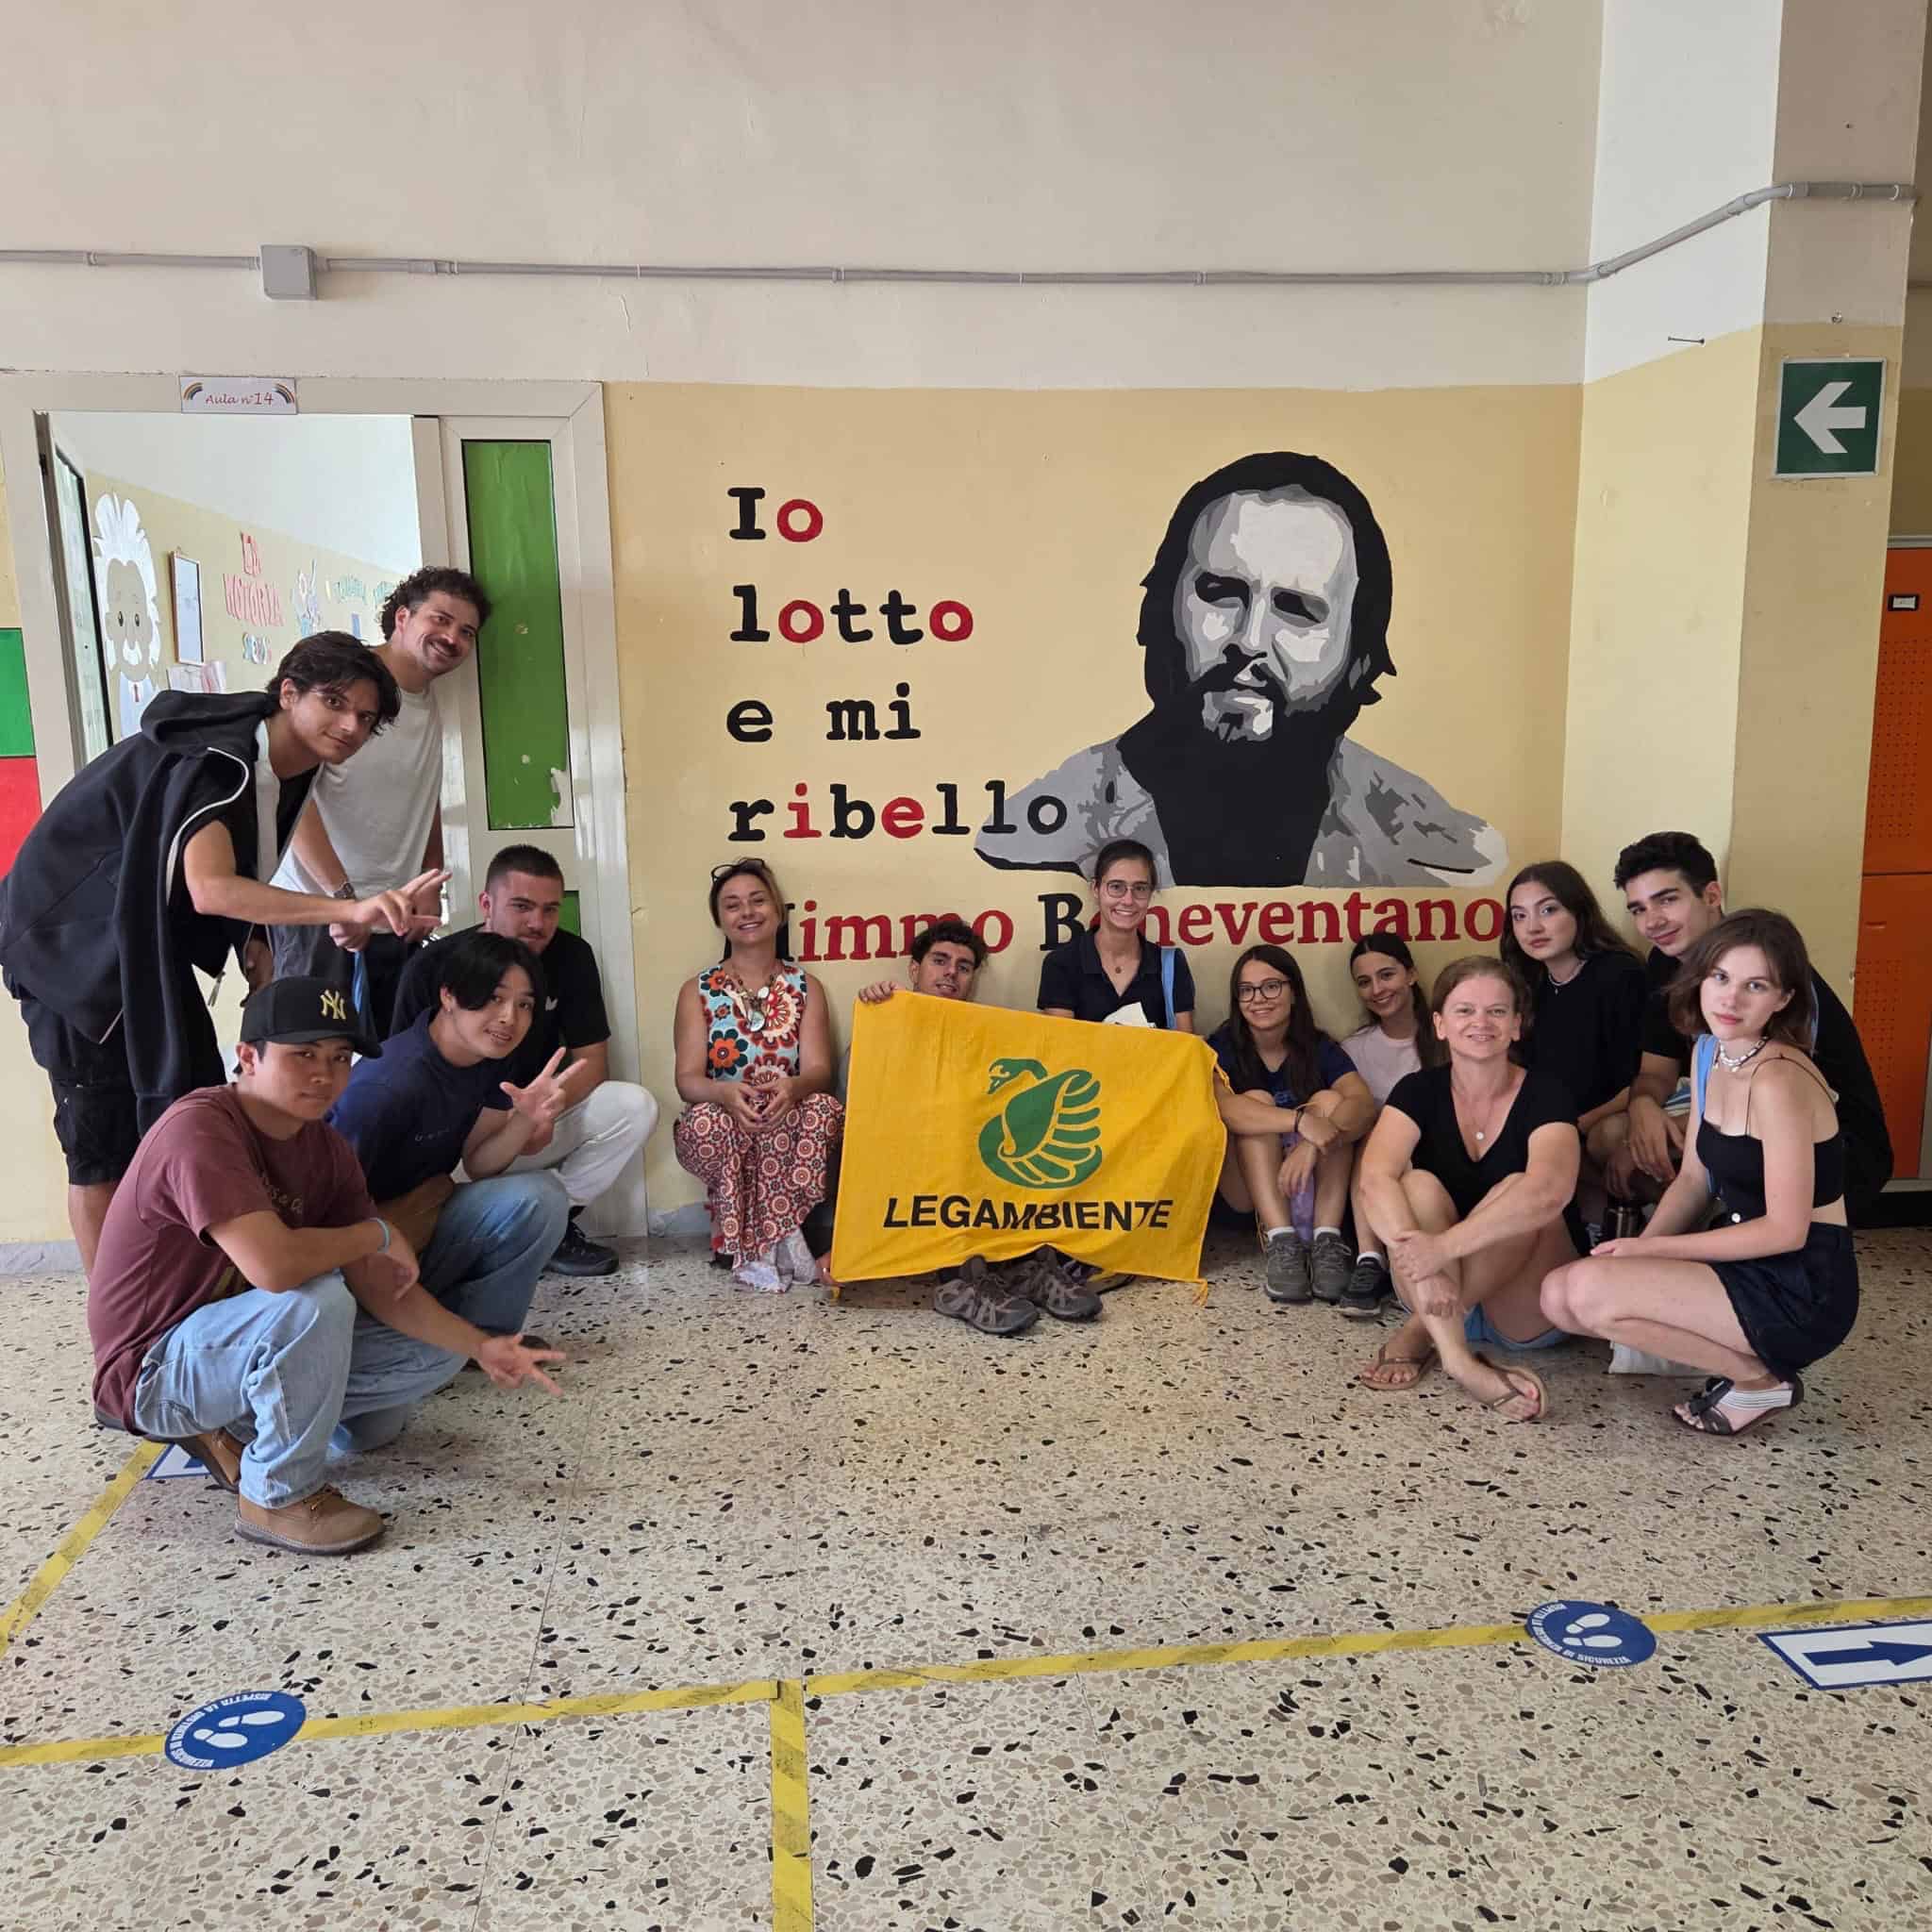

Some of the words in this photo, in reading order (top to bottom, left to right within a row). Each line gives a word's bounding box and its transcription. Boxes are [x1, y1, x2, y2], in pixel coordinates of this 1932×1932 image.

[205, 394, 236, 405] Aula
[726, 487, 824, 542] Io
[729, 584, 974, 644] lotto
[725, 699, 774, 742] e
[824, 681, 922, 741] mi
[726, 779, 1067, 842] ribello
[1038, 891, 1506, 951] Bneventano
[320, 989, 347, 1020] NY
[883, 1194, 1174, 1232] LEGAMBIENTE
